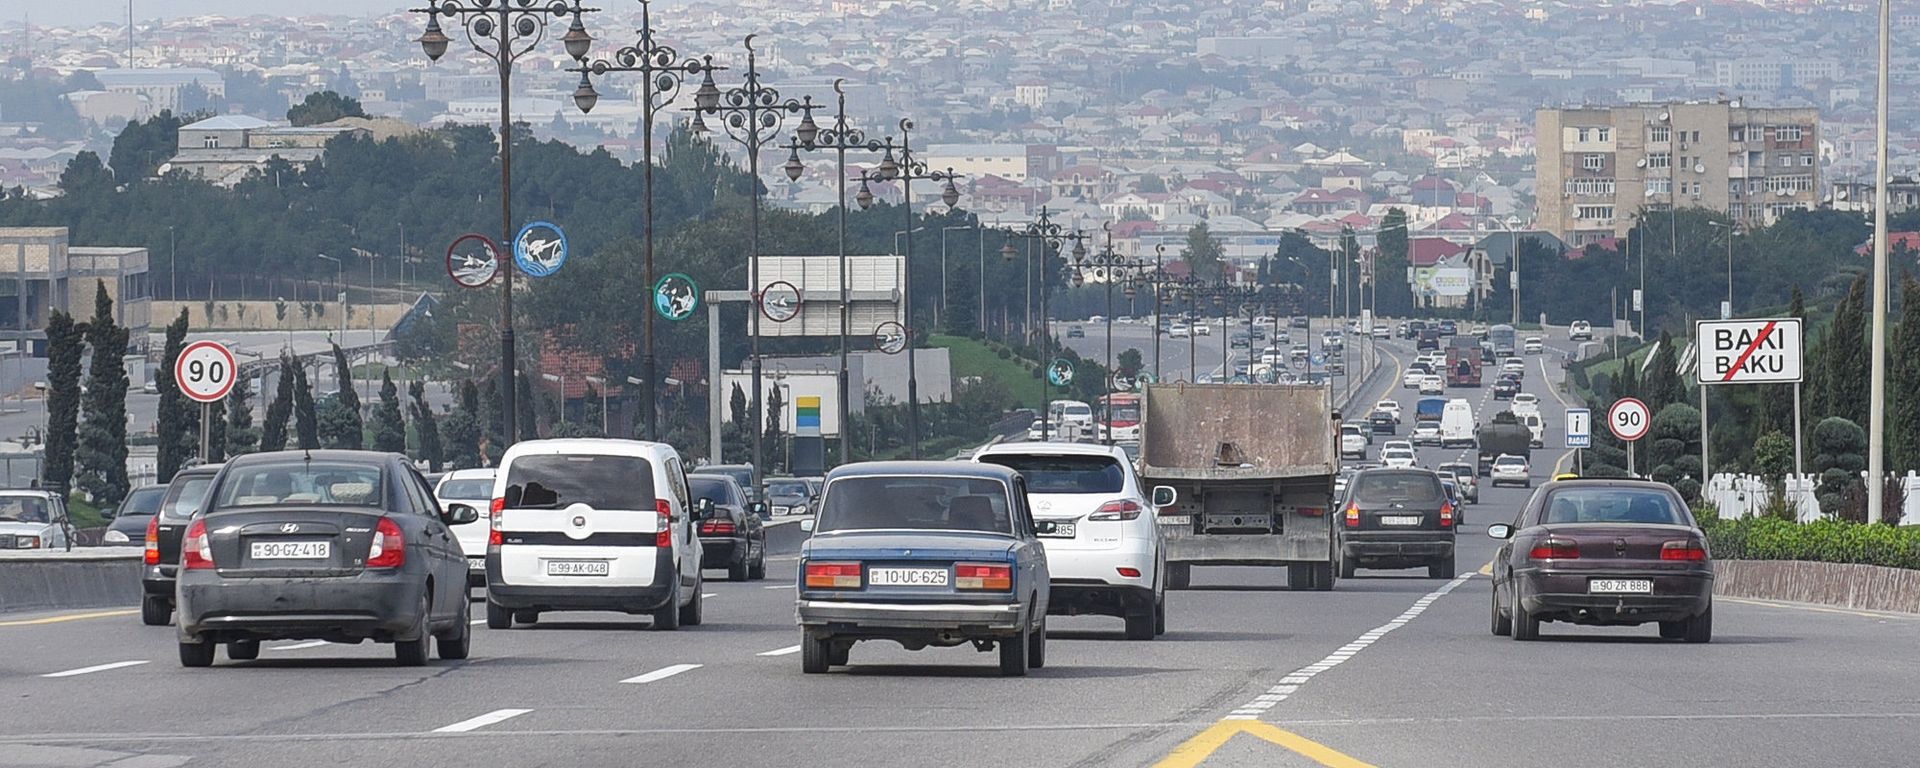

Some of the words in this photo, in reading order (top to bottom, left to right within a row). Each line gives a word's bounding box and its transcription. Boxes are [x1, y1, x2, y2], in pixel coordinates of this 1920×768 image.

[1715, 328, 1784, 350] BAKI
[190, 360, 223, 383] 90
[1715, 355, 1783, 374] BAKU
[1618, 411, 1640, 427] 90
[264, 544, 326, 556] 90-GZ-418
[558, 563, 606, 573] 99-AK-048
[885, 570, 946, 583] 10-UC-625
